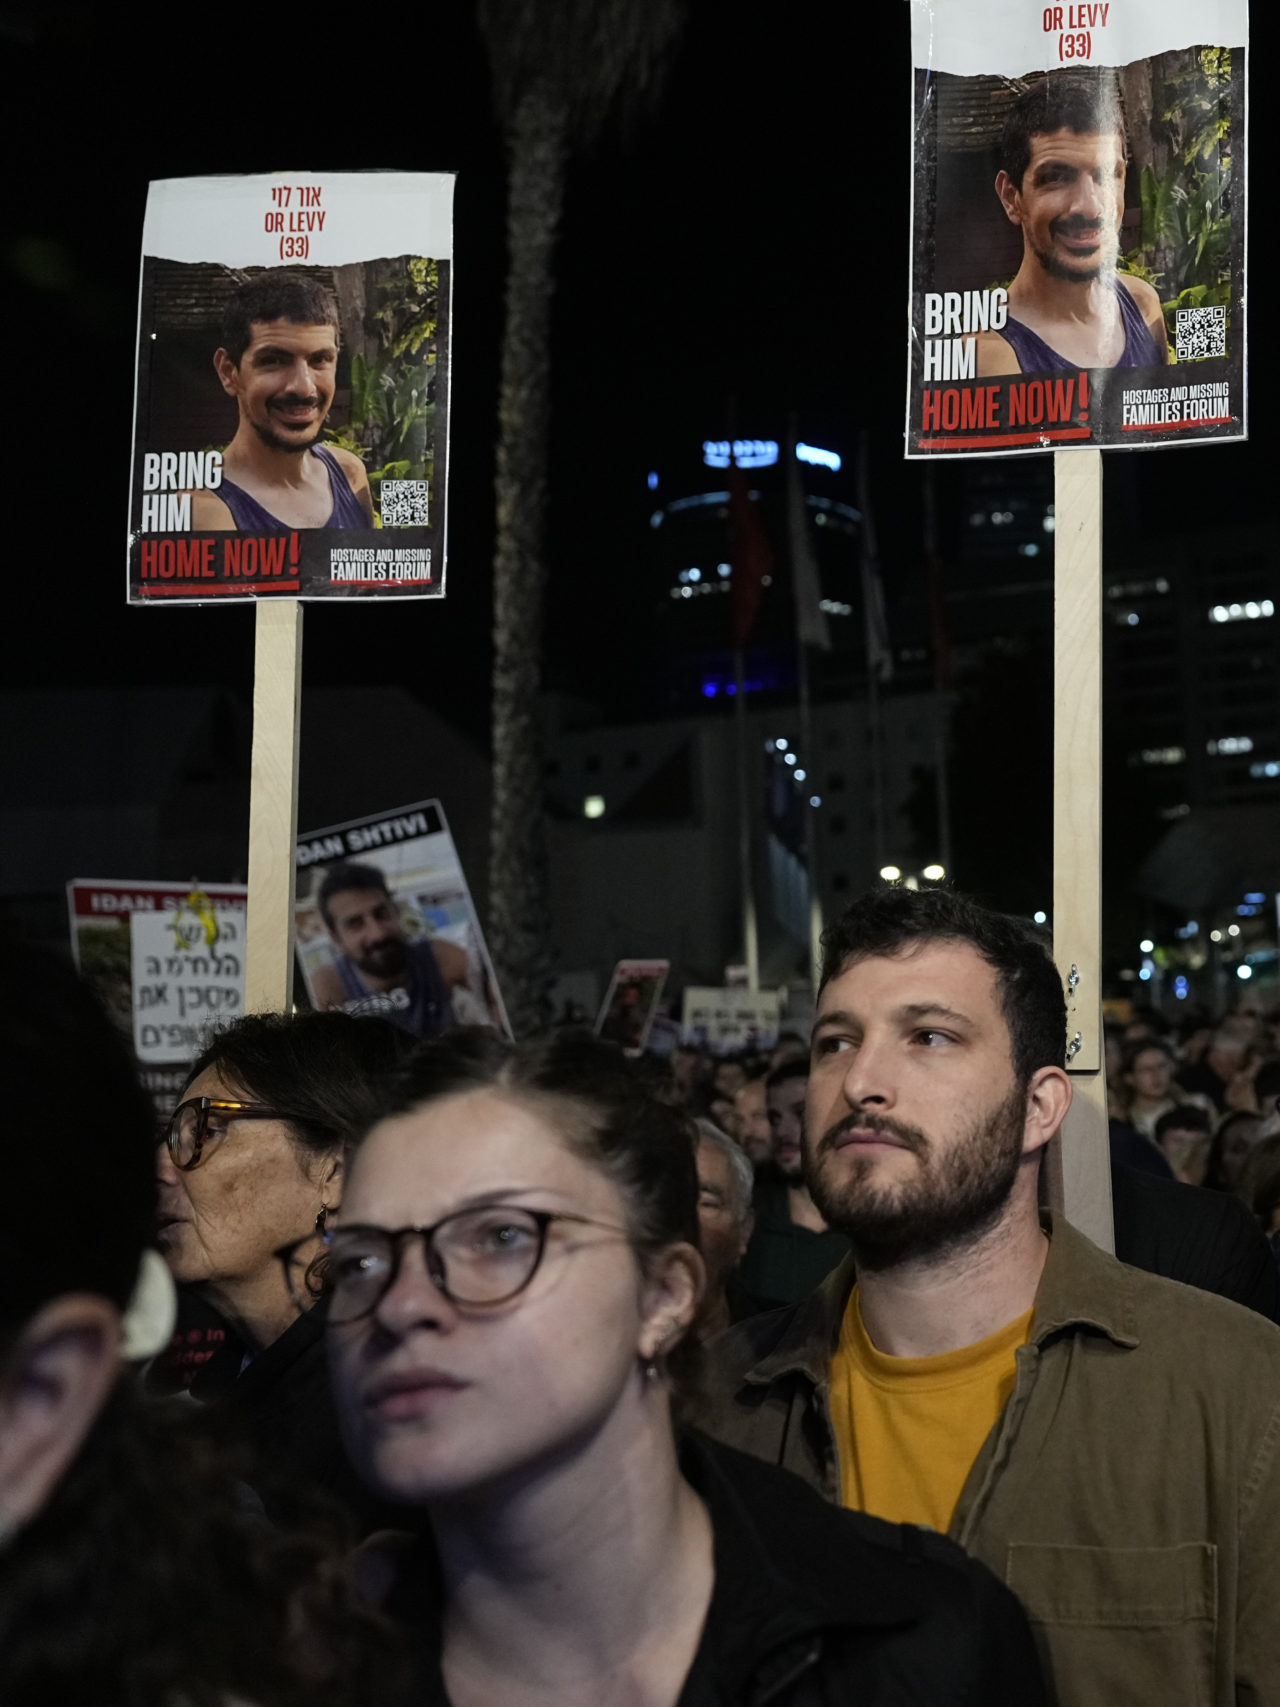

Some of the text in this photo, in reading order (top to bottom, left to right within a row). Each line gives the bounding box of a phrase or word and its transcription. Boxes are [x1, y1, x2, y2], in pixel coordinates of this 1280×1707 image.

[1043, 3, 1110, 32] OR LEVY
[1058, 31, 1092, 61] (33)
[271, 186, 322, 208] אור לוי
[264, 210, 326, 233] OR LEVY
[279, 235, 309, 260] (33)
[924, 287, 1008, 336] BRING
[923, 337, 976, 382] HIM
[921, 371, 1089, 431] HOME NOW!
[1122, 381, 1229, 405] HOSTAGES AND MISSING
[1122, 396, 1229, 426] FAMILIES FORUM
[143, 450, 223, 491] BRING
[141, 493, 192, 533] HIM
[140, 531, 300, 579] HOME NOW!
[330, 548, 432, 562] HOSTAGES AND MISSING
[330, 561, 432, 581] FAMILIES FORUM
[296, 812, 428, 866] DAN SHTIVI
[90, 892, 156, 913] IDAN
